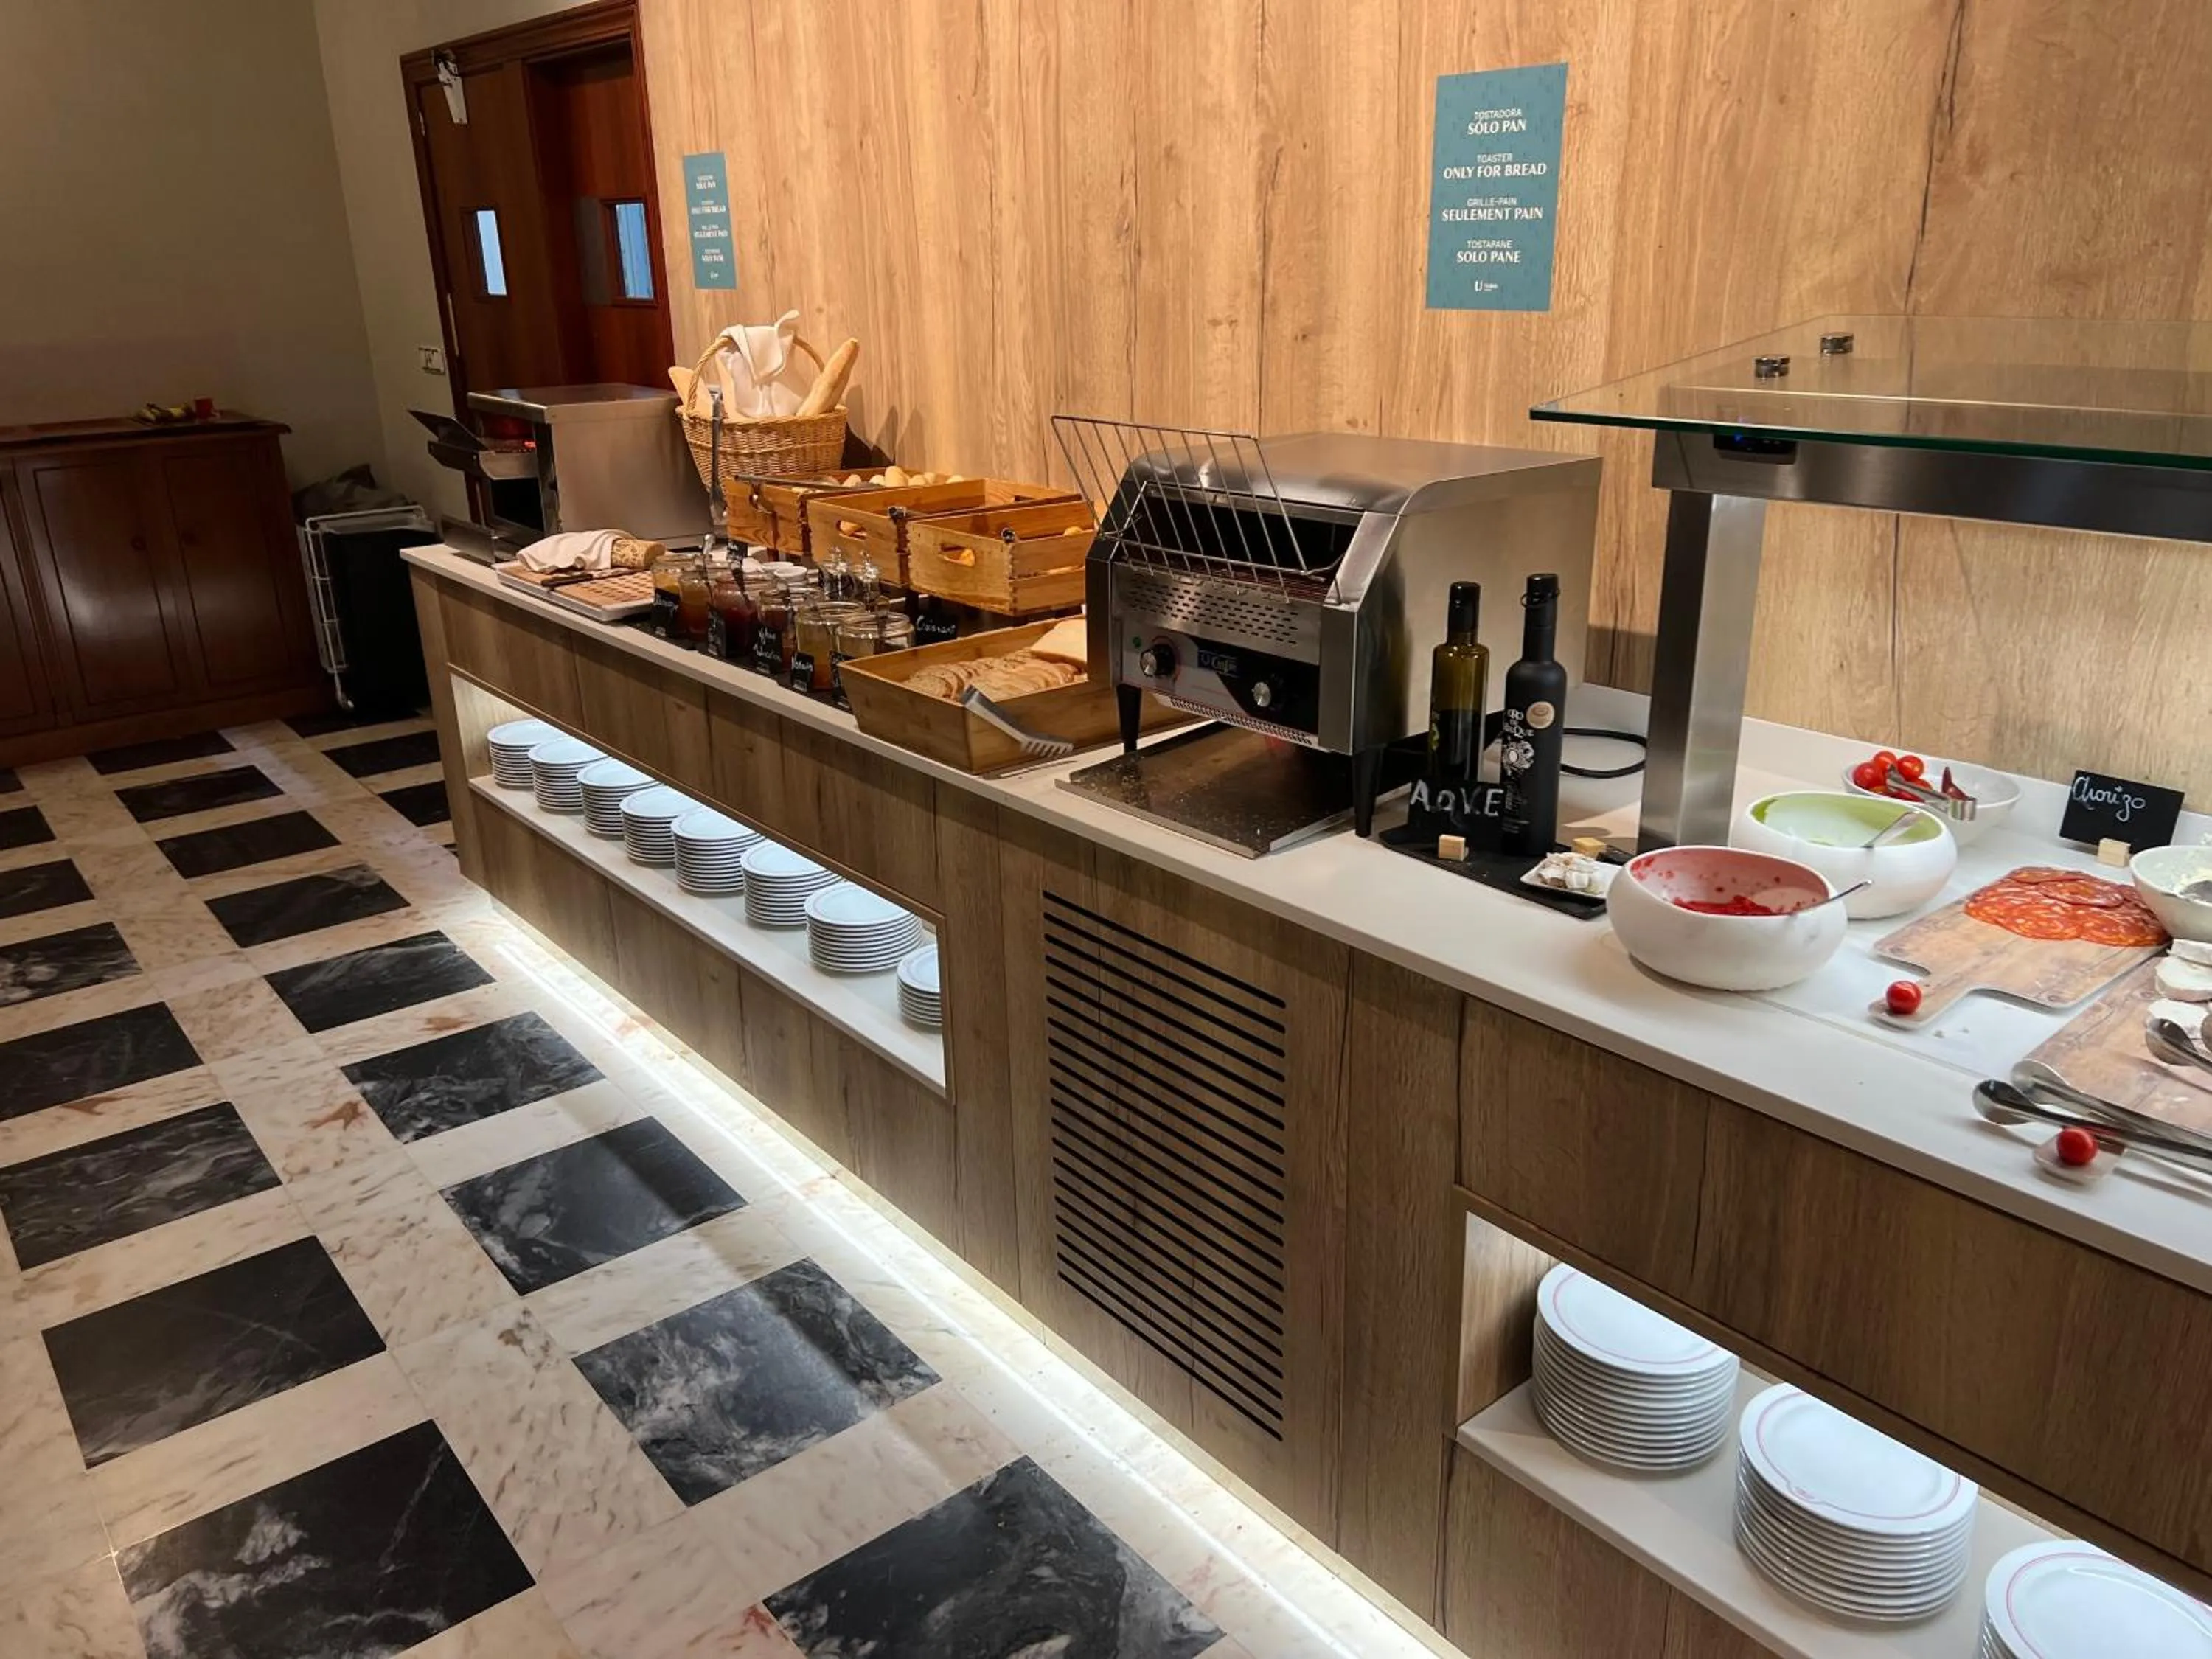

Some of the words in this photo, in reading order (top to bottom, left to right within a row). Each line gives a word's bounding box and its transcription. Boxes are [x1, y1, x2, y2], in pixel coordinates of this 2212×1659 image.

[1474, 108, 1523, 119] TOSTADORA
[1502, 118, 1527, 133] PAN
[1477, 153, 1513, 163] TOASTER
[1443, 166, 1475, 179] ONLY
[1477, 164, 1501, 178] FOR
[1504, 163, 1547, 176] BREAD
[1467, 197, 1517, 207] GRILLE-PAIN
[1442, 208, 1512, 222] SEULEMENT
[1514, 206, 1543, 220] PAIN
[1467, 240, 1513, 249] TOSTAPANE
[1456, 250, 1487, 264] SOLO
[1490, 250, 1521, 263] PANE
